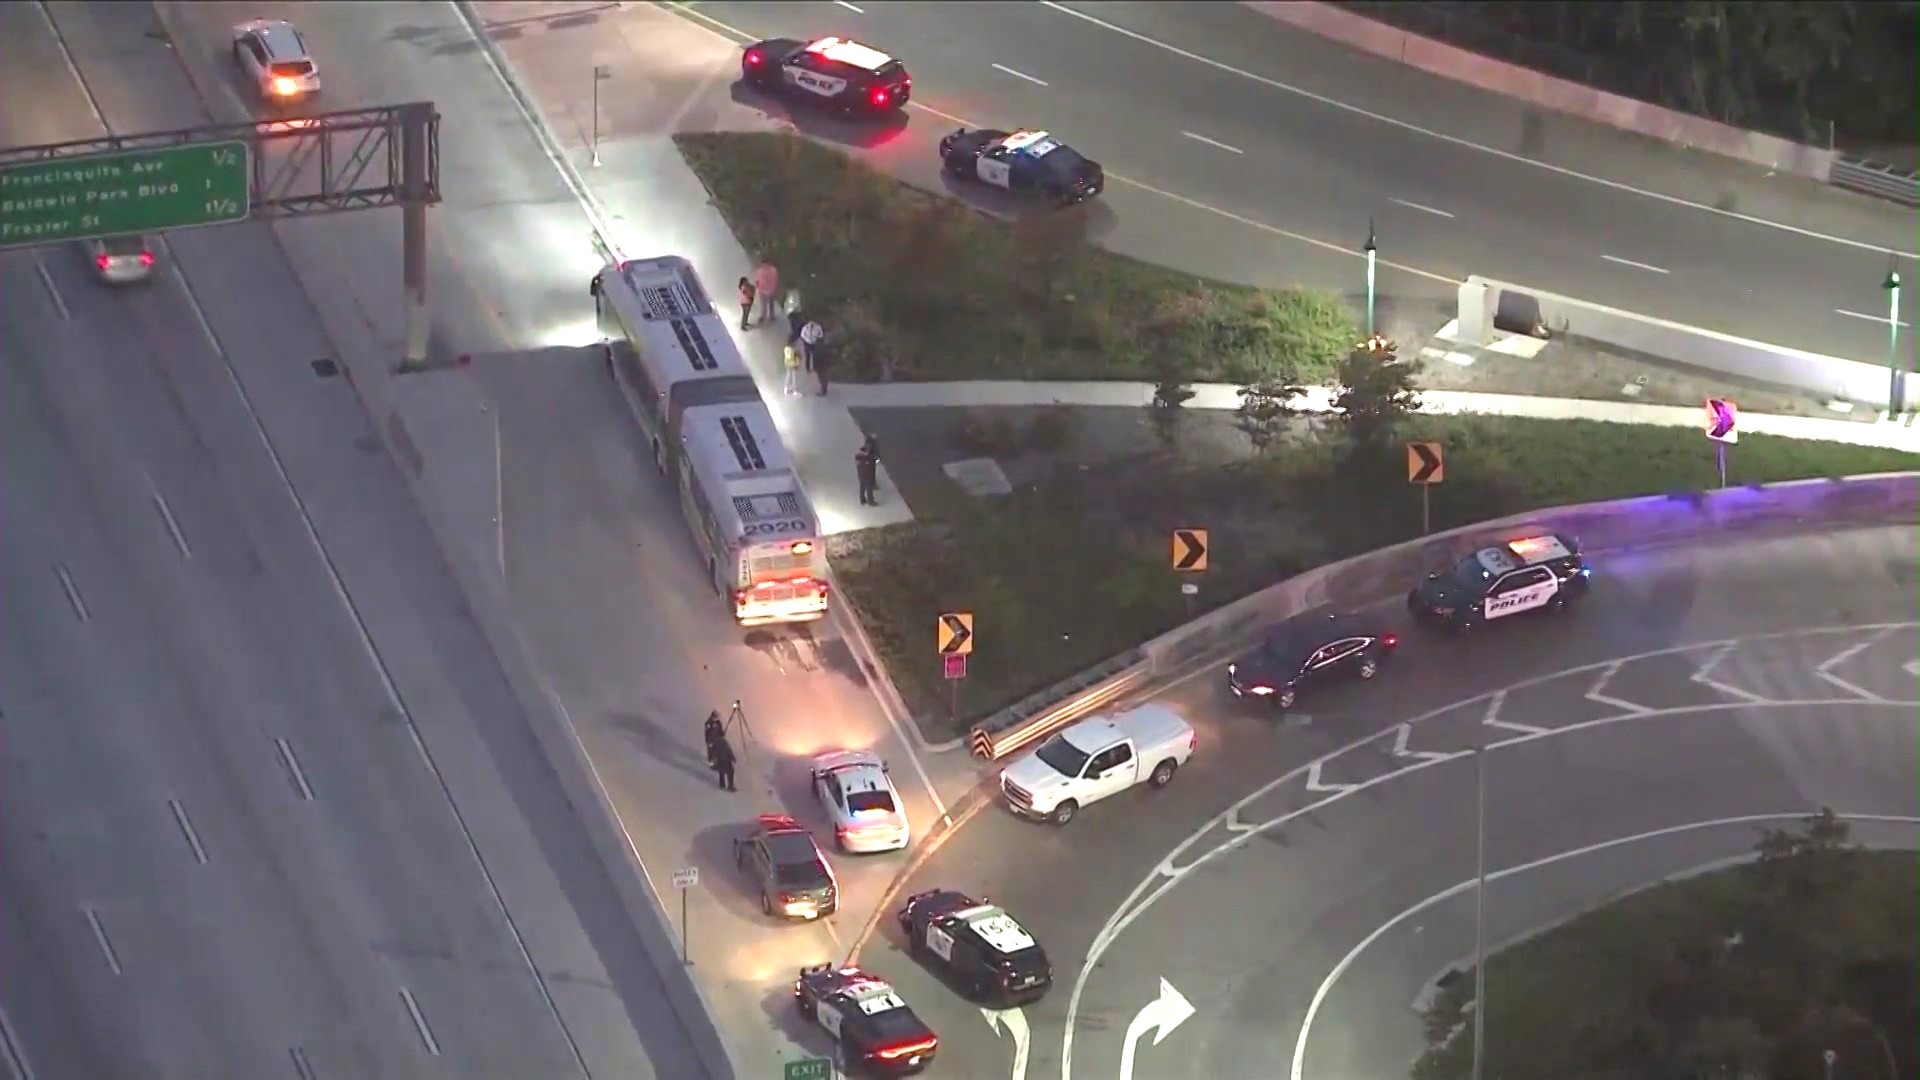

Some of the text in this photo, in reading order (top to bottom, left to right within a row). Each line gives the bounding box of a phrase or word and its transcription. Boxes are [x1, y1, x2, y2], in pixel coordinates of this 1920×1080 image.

[2, 165, 120, 185] Francisquito
[132, 161, 164, 174] Ave
[2, 194, 76, 211] Baldwin
[86, 189, 128, 201] Park
[138, 182, 179, 197] Blvd
[82, 214, 100, 227] St
[744, 520, 806, 535] 2920
[1489, 593, 1540, 612] POLICE
[791, 1063, 822, 1077] EXIT
